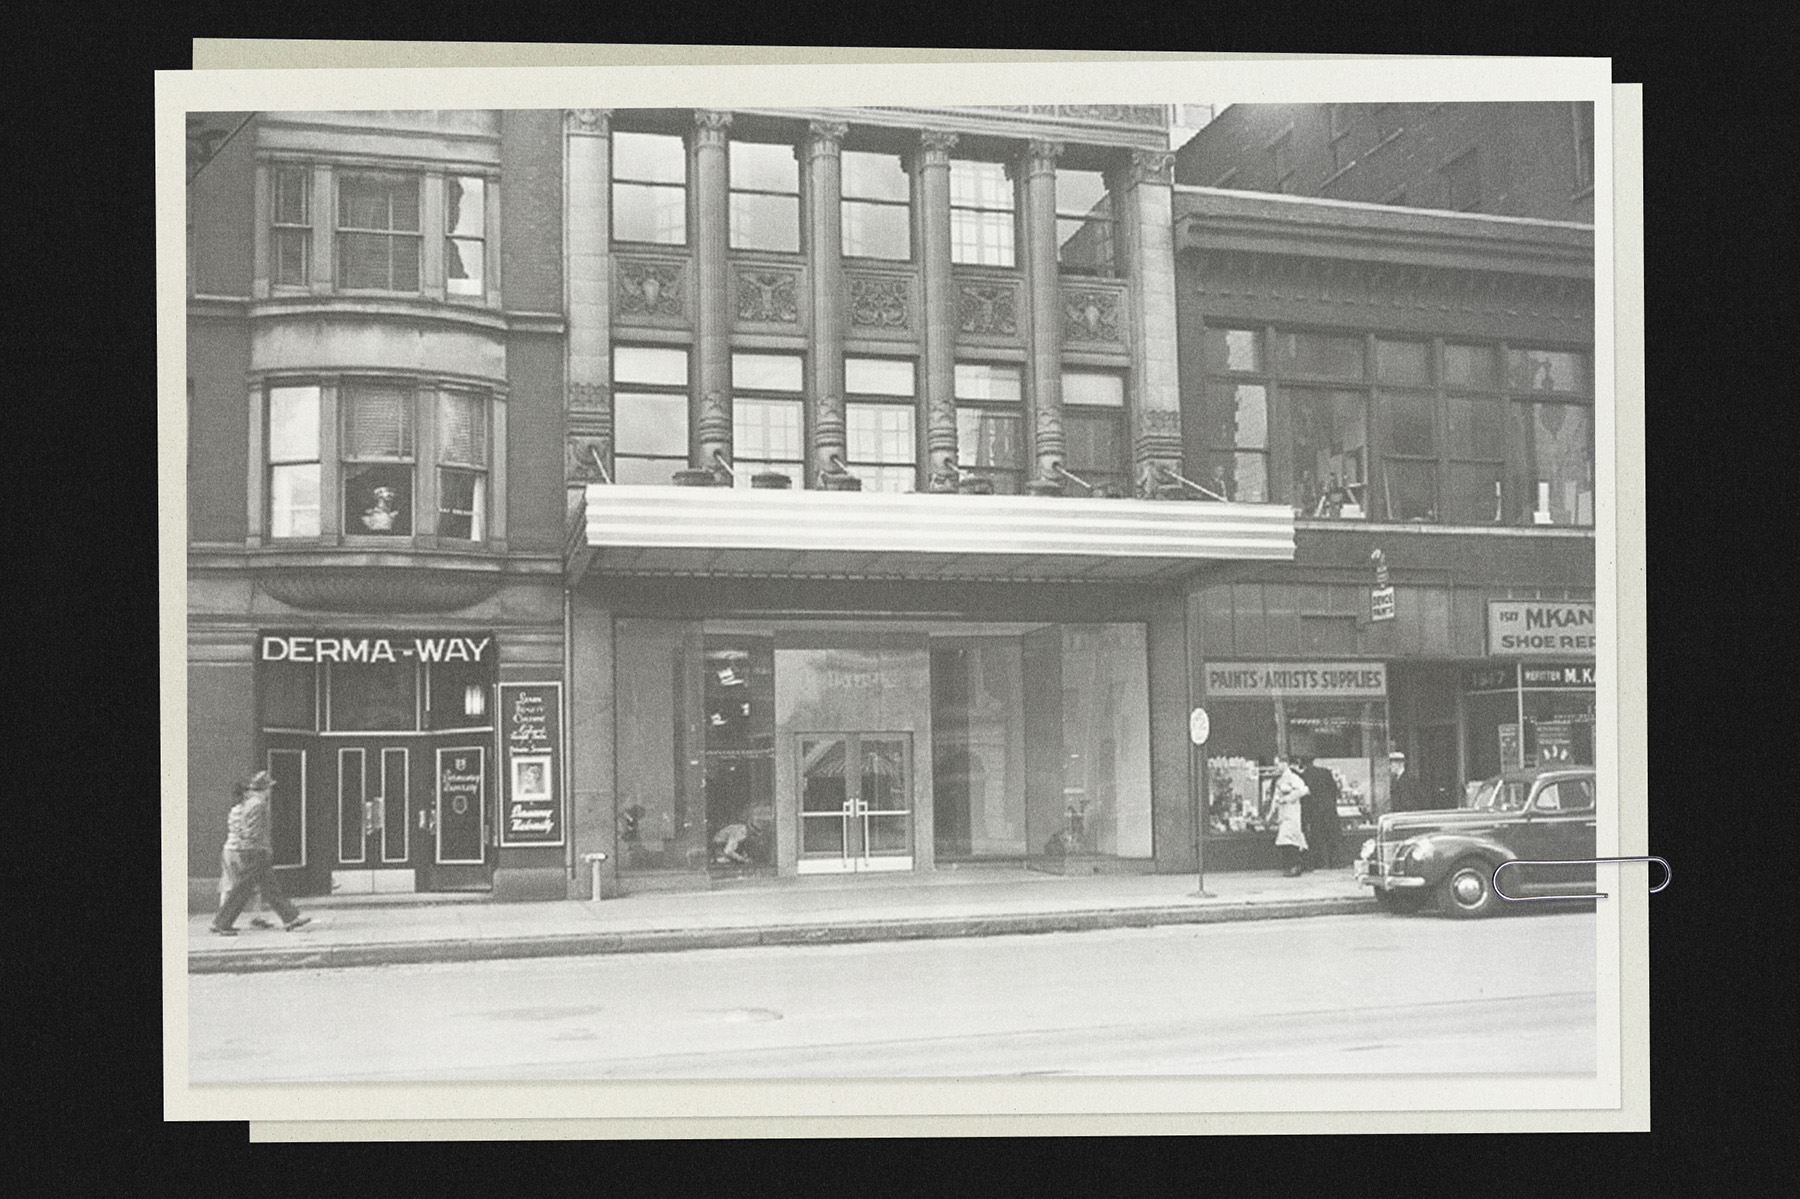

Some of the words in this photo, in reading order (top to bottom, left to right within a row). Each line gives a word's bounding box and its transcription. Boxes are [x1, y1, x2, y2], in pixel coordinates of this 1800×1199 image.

[262, 636, 490, 663] DERMA-WAY
[1502, 635, 1556, 649] SHOE
[1210, 670, 1258, 688] PAINTS
[1321, 670, 1382, 688] SUPPLIES
